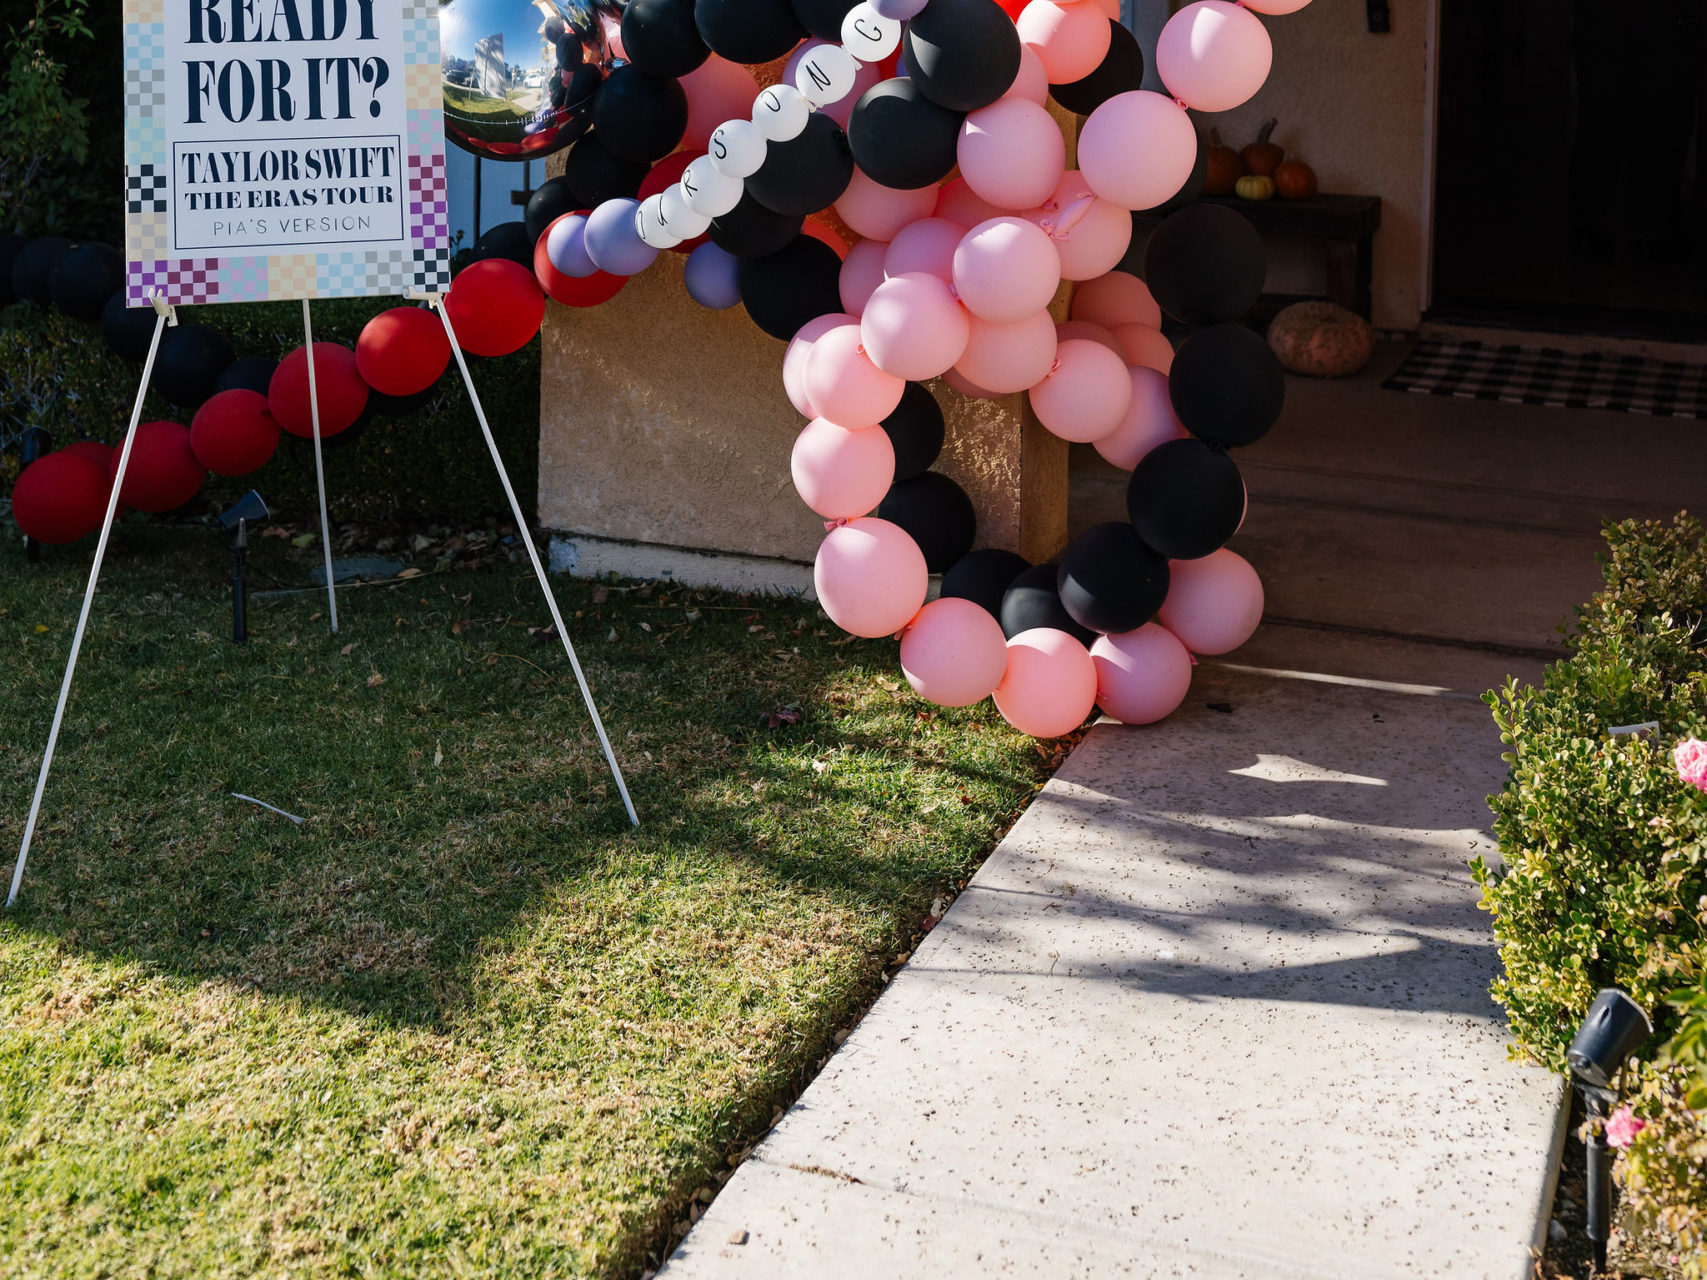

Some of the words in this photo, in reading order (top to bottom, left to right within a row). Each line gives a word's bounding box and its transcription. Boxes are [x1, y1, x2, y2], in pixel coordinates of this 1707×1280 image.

[182, 58, 296, 124] FOR
[302, 56, 390, 121] IT?
[713, 18, 883, 160] SONG
[181, 149, 301, 184] TAYLOR
[304, 146, 395, 180] SWIFT
[184, 190, 242, 211] THE
[247, 187, 318, 209] ERAS
[321, 185, 395, 206] TOUR
[212, 218, 268, 237] PIA'S
[279, 215, 371, 234] VERSION
